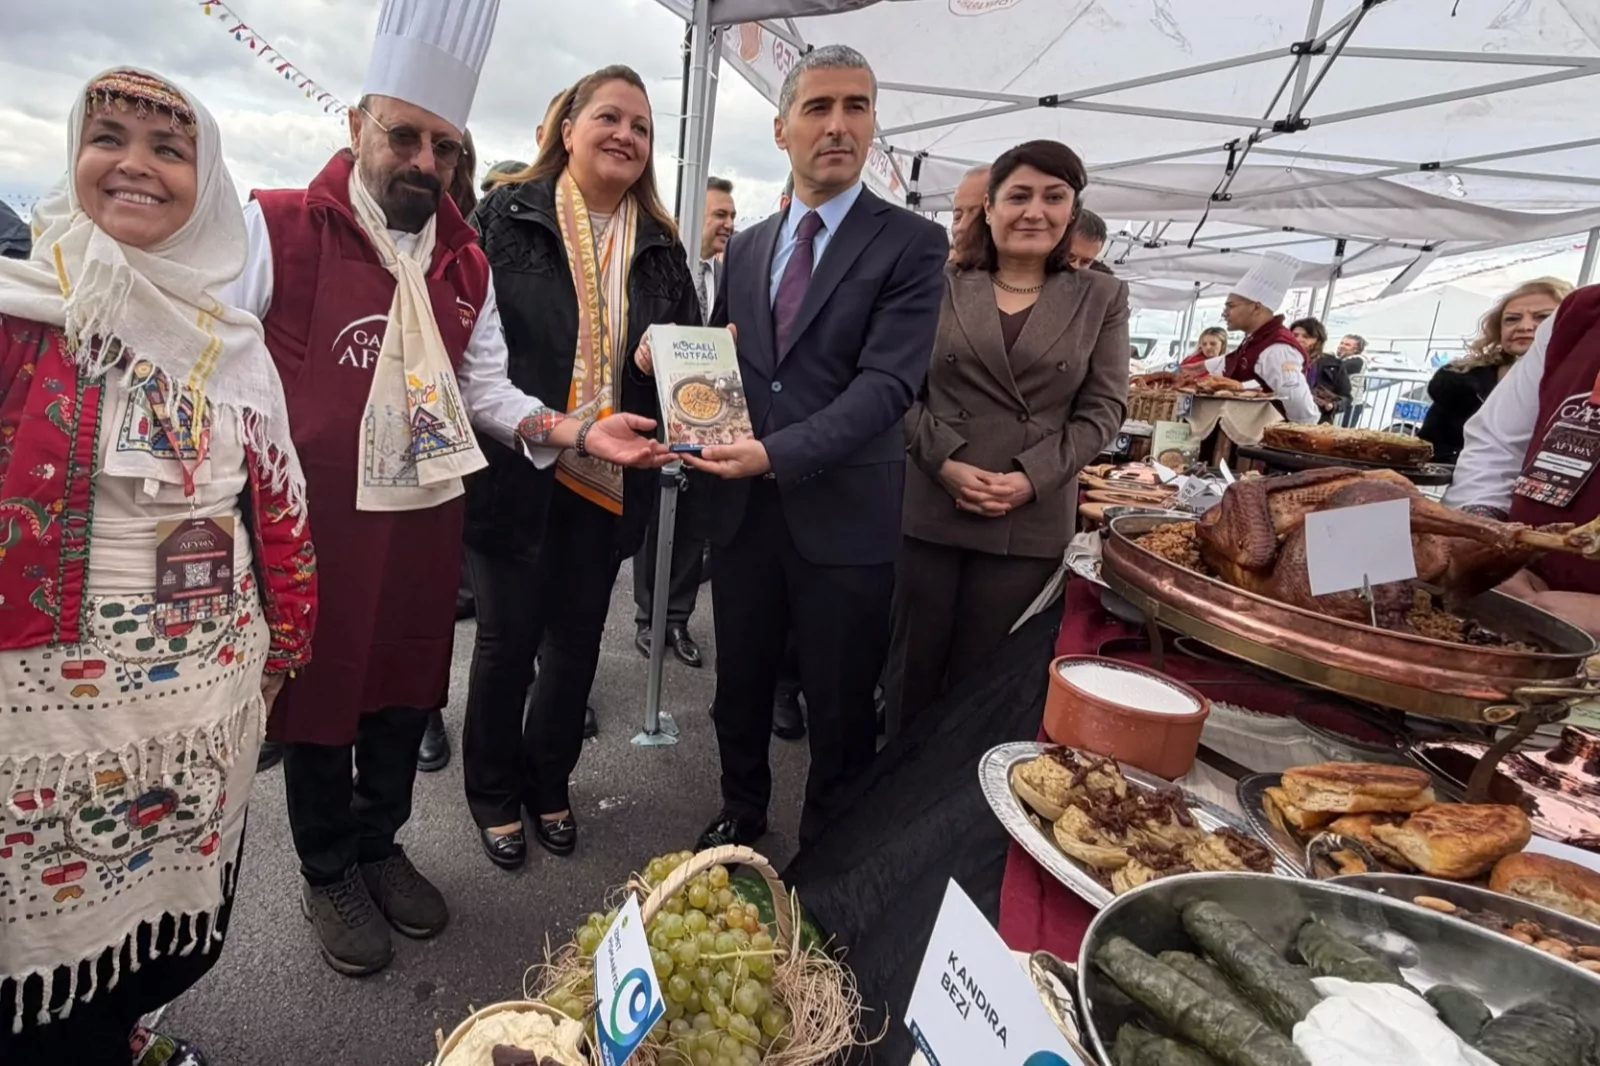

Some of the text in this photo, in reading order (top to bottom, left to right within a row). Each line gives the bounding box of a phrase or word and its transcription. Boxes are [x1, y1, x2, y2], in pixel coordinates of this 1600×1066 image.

[353, 330, 381, 348] GA
[672, 341, 716, 352] KOCAELİ
[338, 345, 379, 369] AF
[674, 352, 718, 361] MUTFAĞI
[940, 971, 972, 1021] BEZİ
[947, 950, 1008, 1049] KANDIRA
